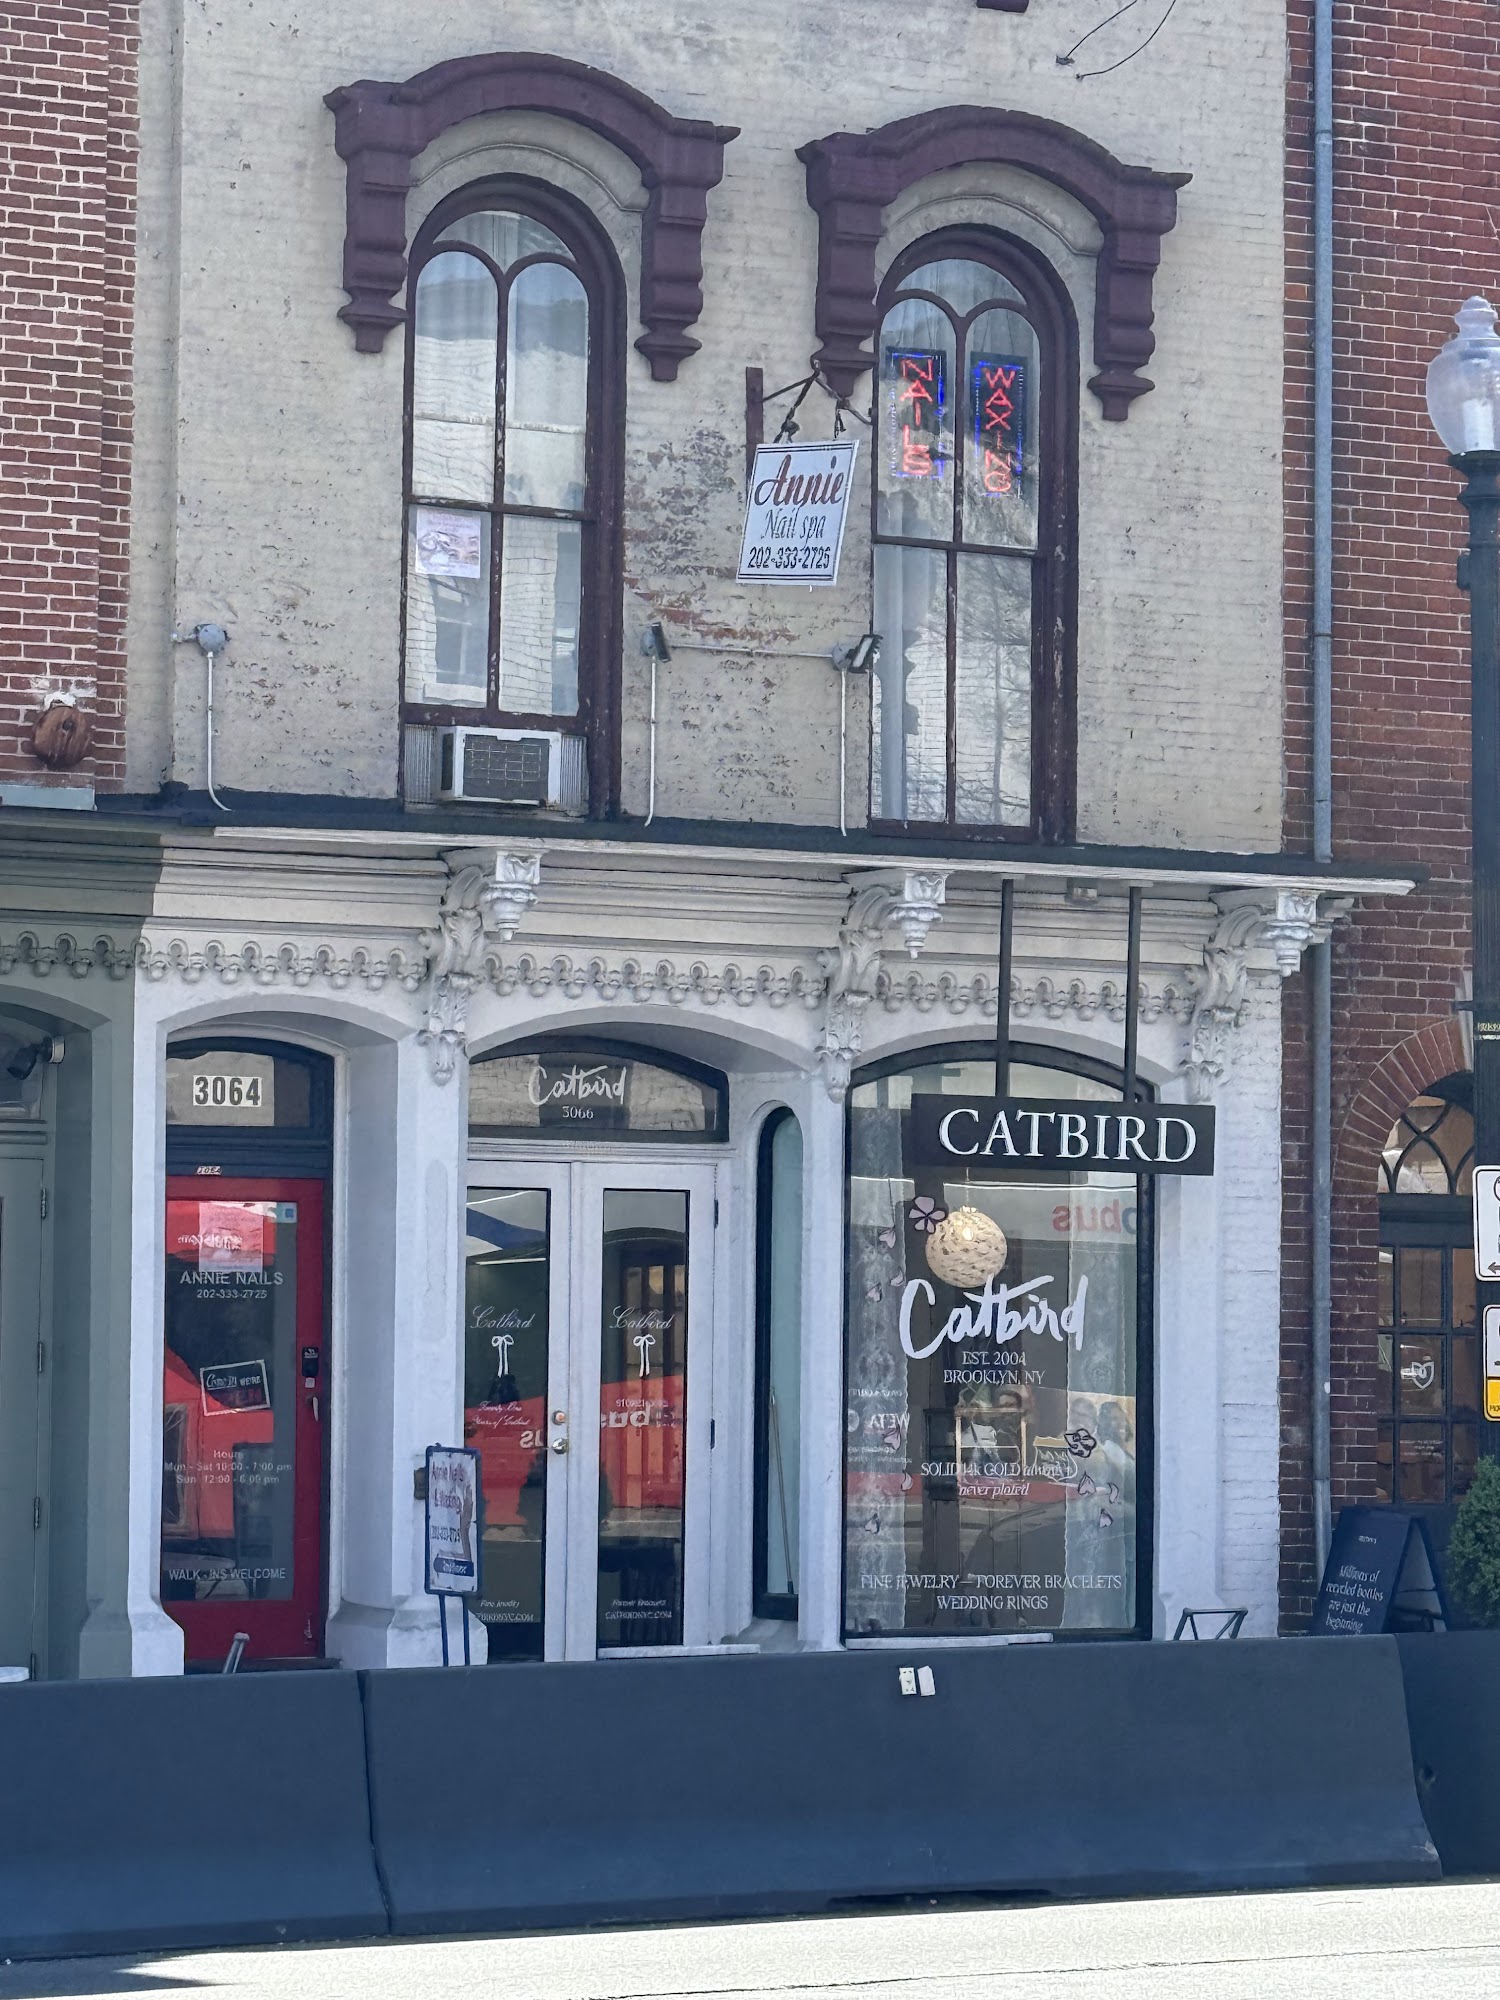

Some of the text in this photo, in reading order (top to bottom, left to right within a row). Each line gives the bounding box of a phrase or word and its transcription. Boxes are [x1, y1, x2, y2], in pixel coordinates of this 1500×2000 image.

[900, 357, 934, 475] NAILS
[984, 366, 1016, 493] WAXING
[754, 453, 845, 507] Annie
[761, 506, 827, 551] Nail spa
[748, 546, 832, 570] 202-333-2725
[194, 1076, 261, 1106] 3064
[528, 1064, 628, 1106] Catbird
[561, 1105, 595, 1120] 3066
[938, 1108, 1198, 1164] CATBIRD
[179, 1271, 284, 1287] ANNIE NAILS
[196, 1289, 268, 1300] 202-333-2725
[470, 1305, 536, 1330] Catbird
[609, 1305, 676, 1330] Catbird
[899, 1273, 1089, 1360] Catbird
[993, 1350, 1027, 1366] 2004
[943, 1369, 1046, 1386] BROOKLYN, NY
[213, 1449, 244, 1459] Hours
[164, 1462, 186, 1472] Mon
[920, 1461, 959, 1476] SOLID
[983, 1461, 1021, 1476] GOLD
[204, 1474, 230, 1484] 12:00
[959, 1482, 1030, 1500] never plated
[168, 1569, 201, 1581] WALK
[230, 1568, 287, 1580] WELCOME
[861, 1574, 893, 1589] FINE
[896, 1574, 960, 1590] JEWELRY
[975, 1574, 1041, 1589] FOREVER
[1045, 1574, 1122, 1589] BRACELETS
[1340, 1565, 1380, 1582] Millions of
[1326, 1582, 1383, 1601] recycled bottles
[937, 1595, 1049, 1610] WEDDING RINGS
[1328, 1599, 1371, 1616] are just the
